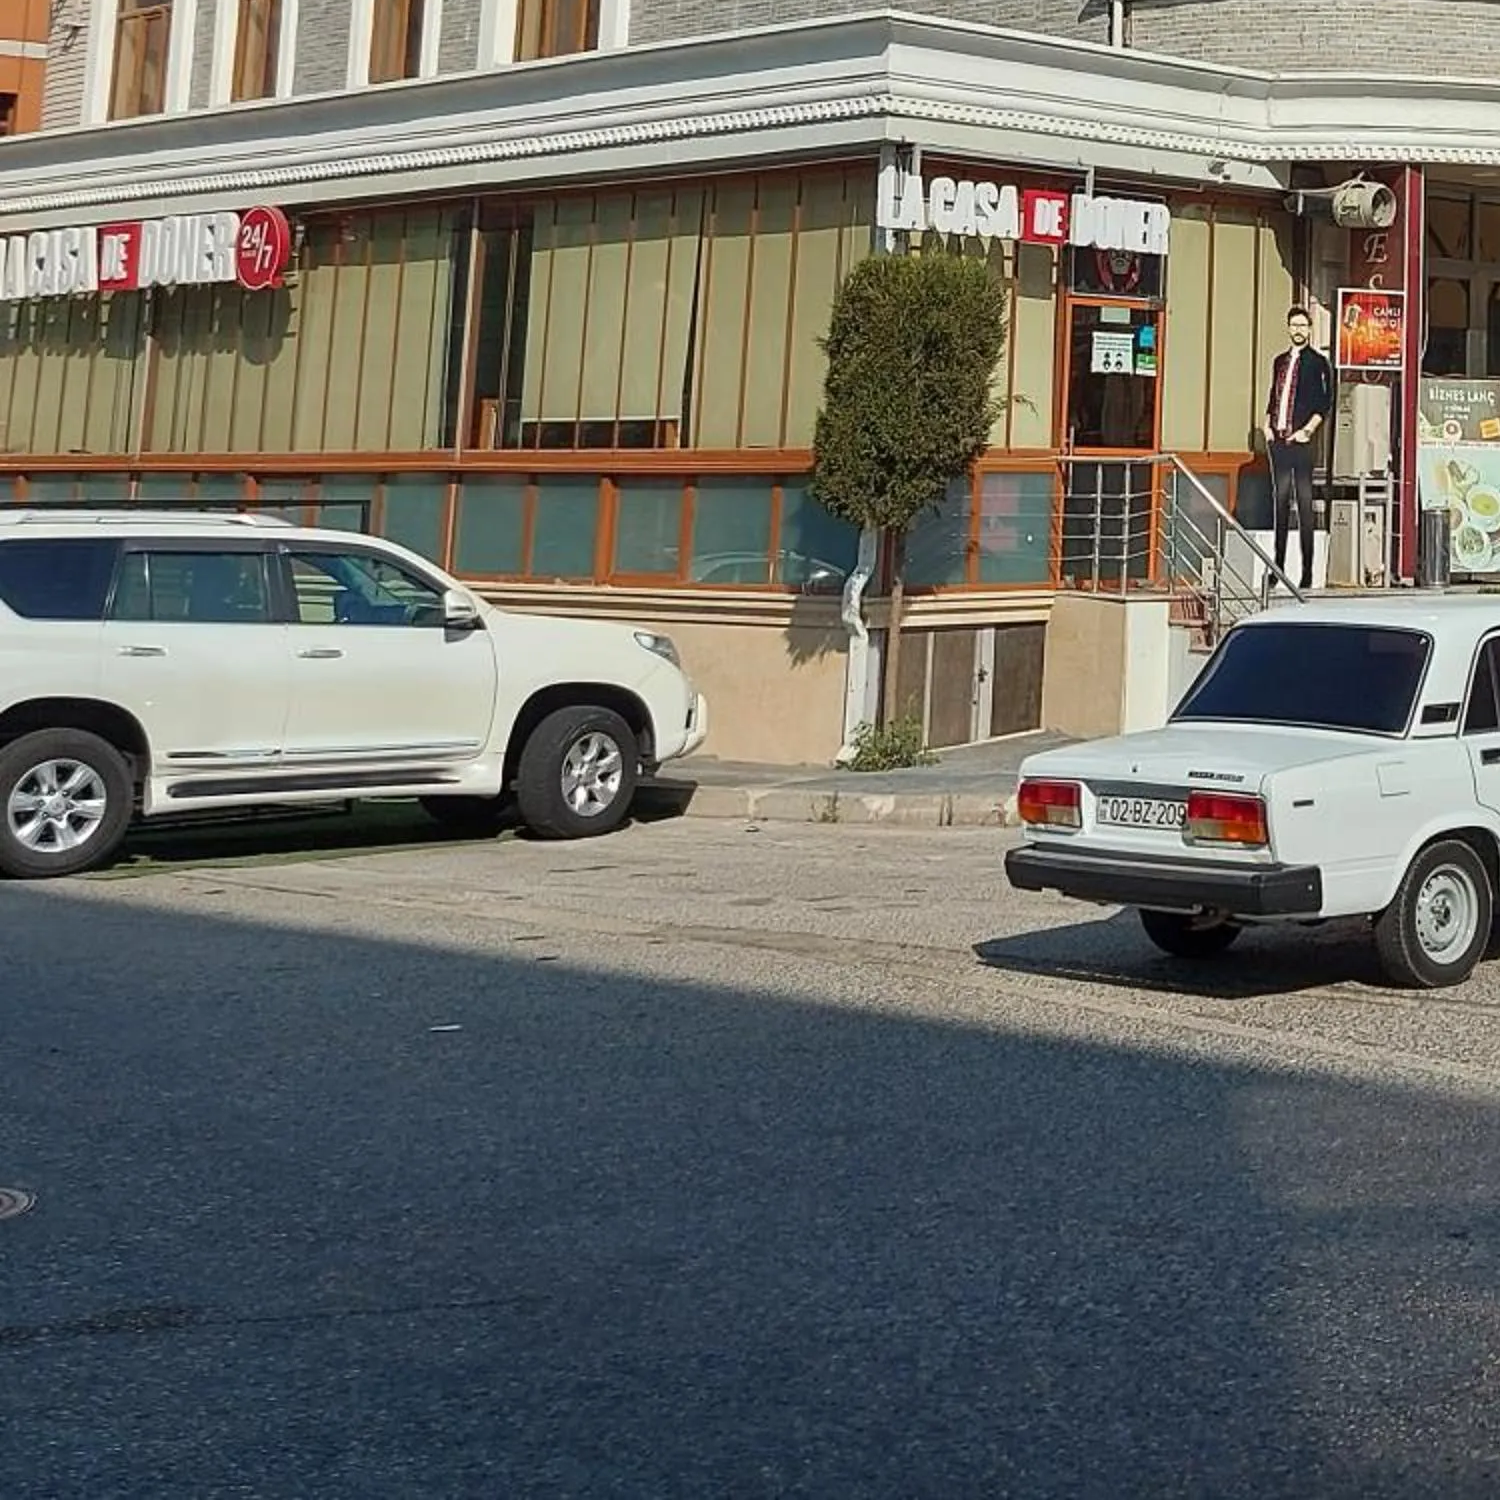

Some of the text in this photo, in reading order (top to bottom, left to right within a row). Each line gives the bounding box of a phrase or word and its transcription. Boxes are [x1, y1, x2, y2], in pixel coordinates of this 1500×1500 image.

[876, 165, 926, 230] LA
[929, 177, 1022, 239] CASA
[1033, 198, 1067, 237] DE
[27, 227, 98, 298] CASA
[101, 233, 131, 281] DE
[241, 221, 273, 274] 24/7
[1109, 799, 1187, 827] 02-BZ-209
